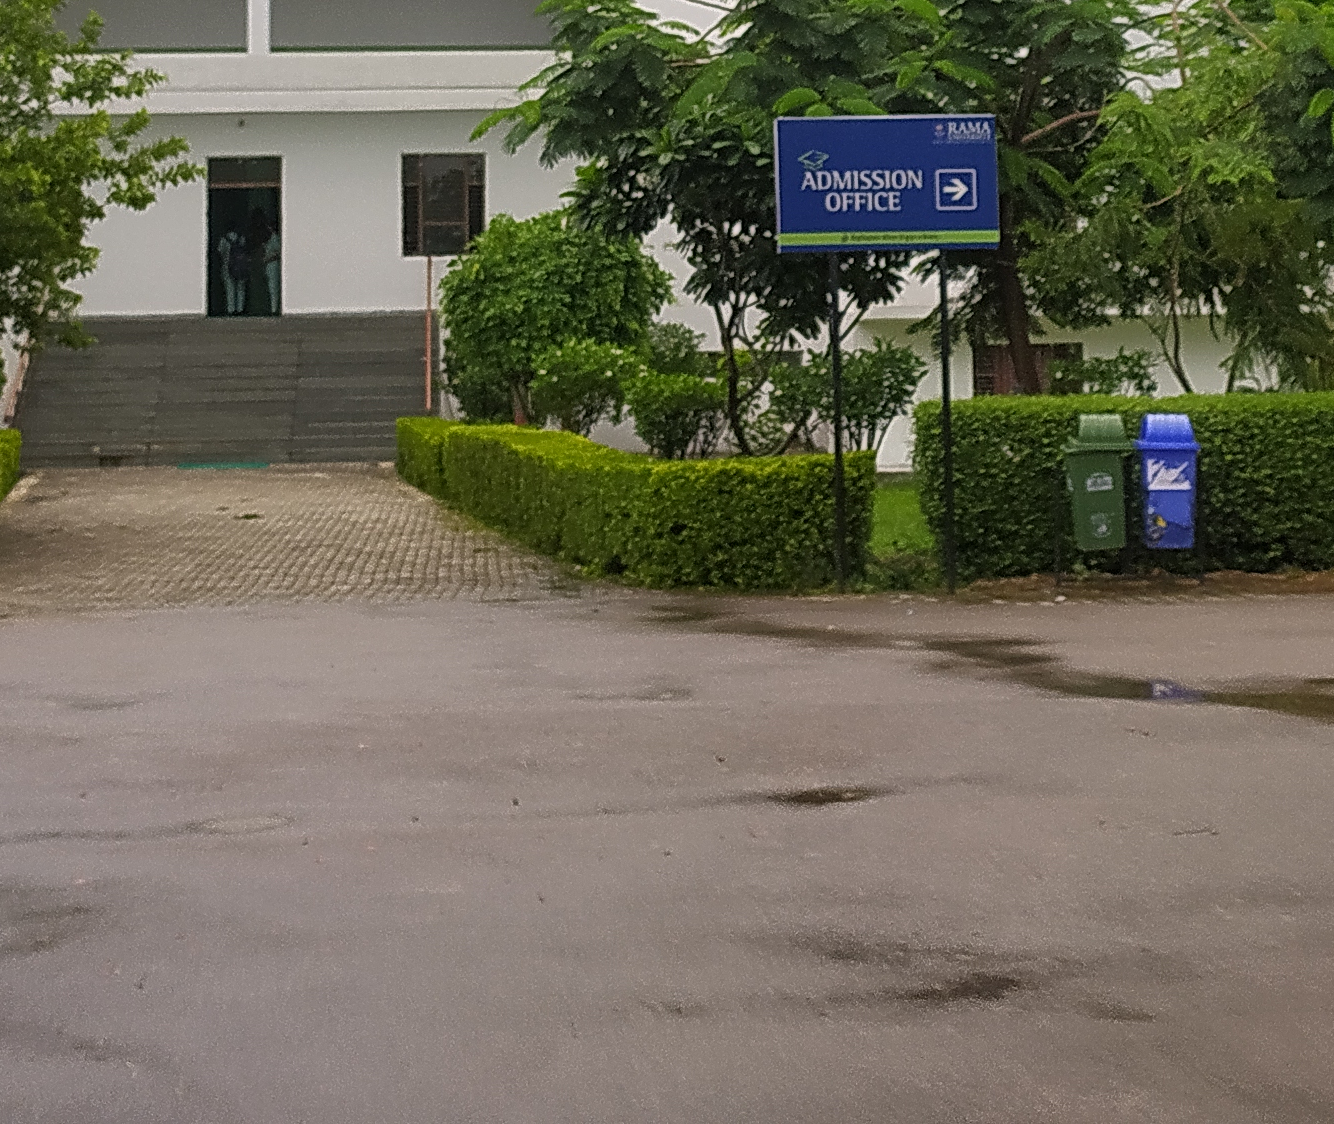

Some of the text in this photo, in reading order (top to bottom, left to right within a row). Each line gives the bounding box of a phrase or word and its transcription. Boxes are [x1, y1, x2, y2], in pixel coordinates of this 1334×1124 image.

[948, 121, 991, 135] RAMA
[801, 169, 924, 192] ADMISSION
[825, 191, 902, 213] OFFICE
